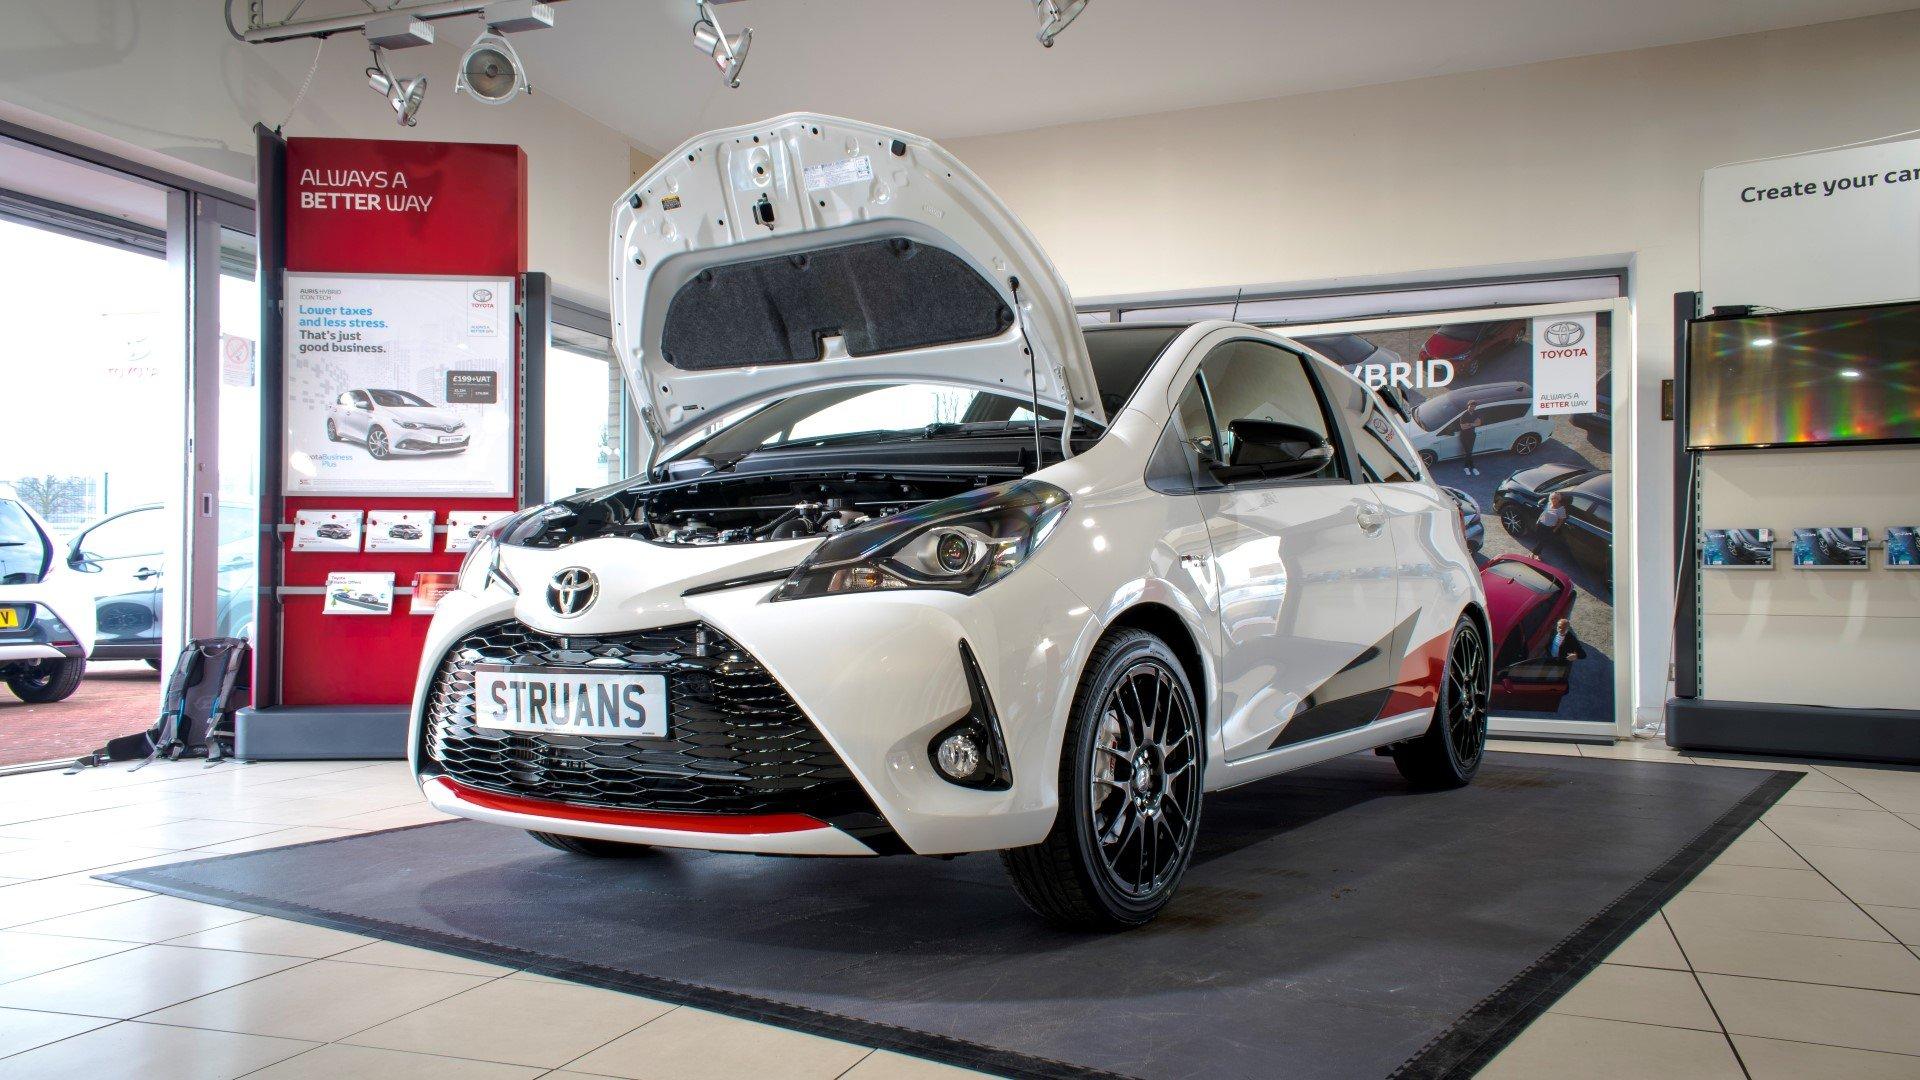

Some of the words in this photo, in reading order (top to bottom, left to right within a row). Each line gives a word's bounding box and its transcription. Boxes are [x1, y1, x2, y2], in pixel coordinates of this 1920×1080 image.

[300, 169, 388, 188] ALWAYS
[392, 171, 408, 189] A
[1741, 181, 1817, 203] Create
[1823, 173, 1878, 197] your
[1884, 168, 1920, 184] car
[301, 191, 382, 210] BETTER
[385, 194, 433, 212] WAY
[299, 304, 337, 315] Lower
[340, 306, 373, 316] taxes
[299, 317, 321, 327] and
[324, 317, 347, 328] less
[349, 318, 388, 328] stress.
[300, 330, 336, 341] That's
[337, 331, 361, 343] just
[300, 342, 330, 354] good
[331, 342, 386, 354] business.
[1540, 348, 1588, 360] TOYOTA
[1541, 393, 1573, 401] ALWAYS
[1573, 392, 1580, 400] A
[1540, 401, 1570, 409] BETTER
[491, 680, 647, 729] STRUANS
